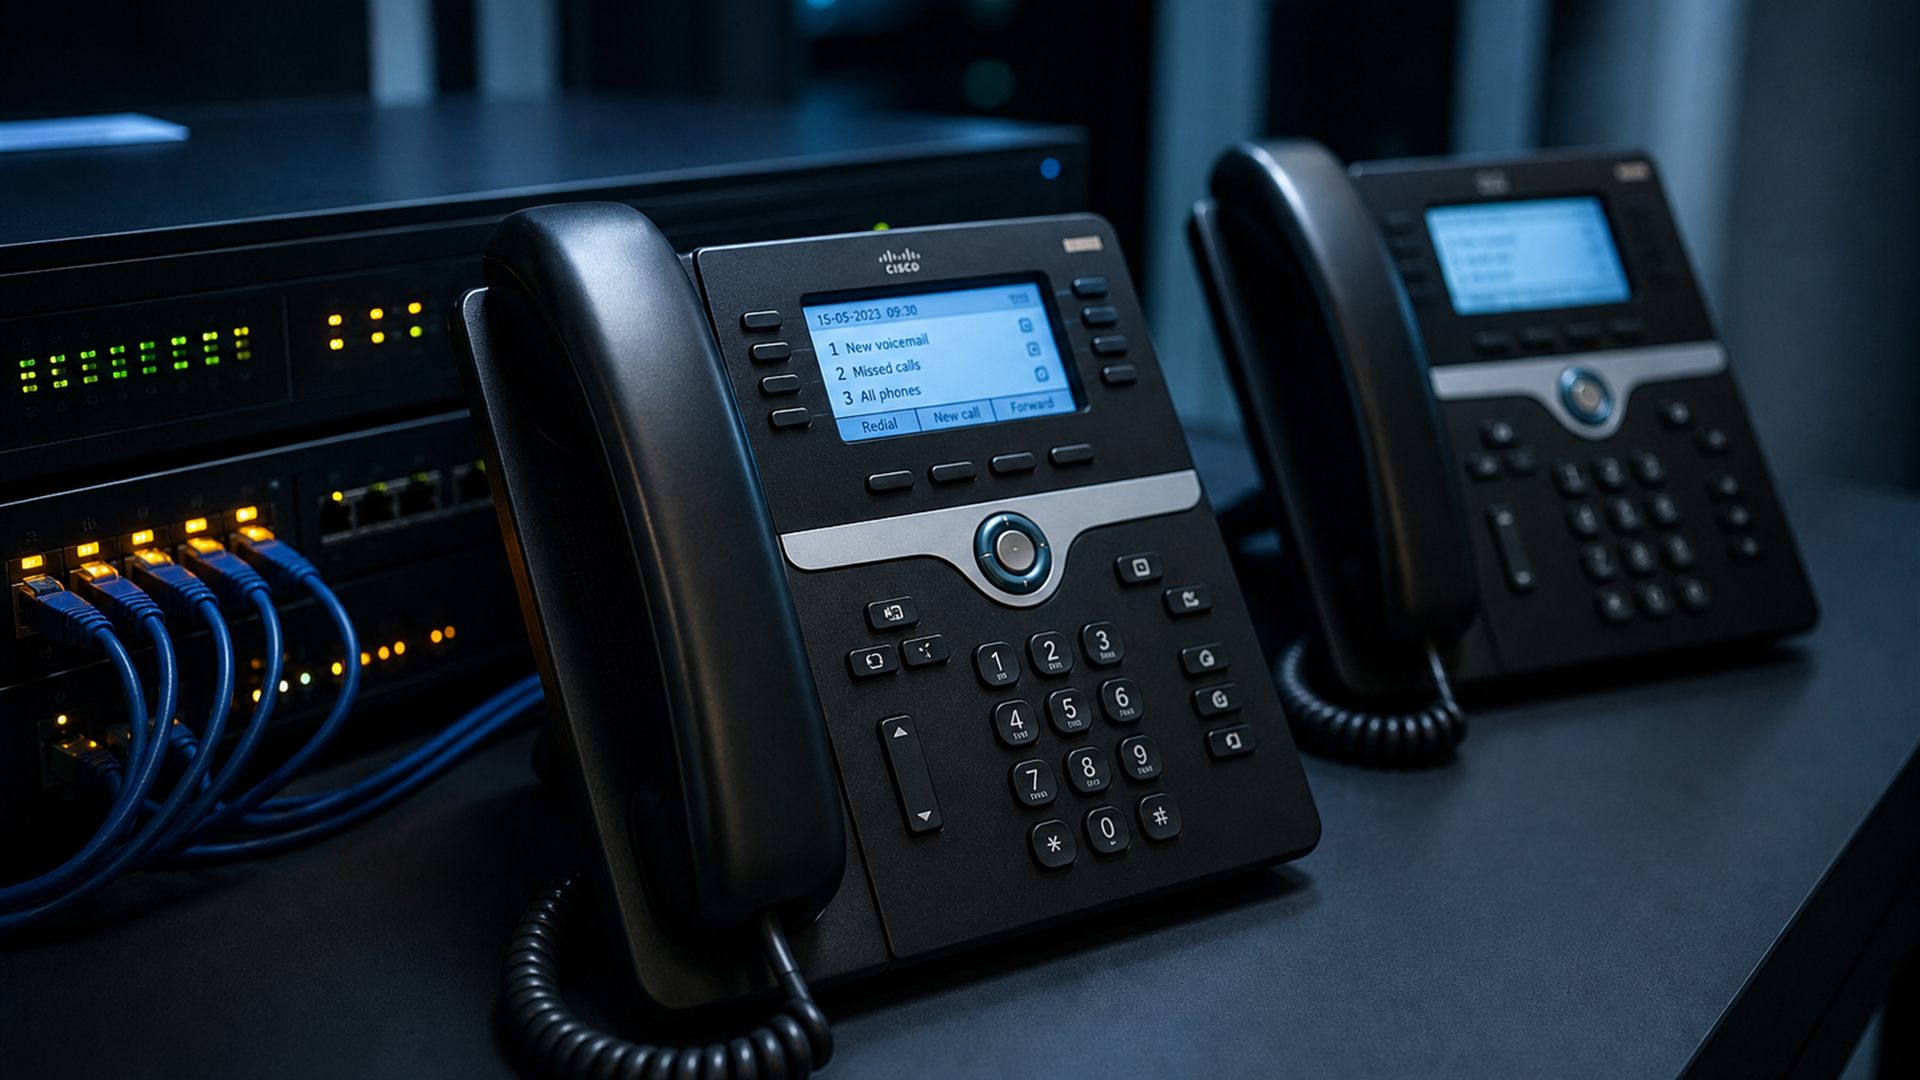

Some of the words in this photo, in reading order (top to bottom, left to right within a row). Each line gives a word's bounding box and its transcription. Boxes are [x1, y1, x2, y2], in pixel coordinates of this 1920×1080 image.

[886, 262, 920, 275] CISCO
[817, 308, 881, 326] 15-05-2023
[887, 304, 917, 318] 09:30
[829, 343, 839, 356] 1
[846, 341, 872, 355] New
[876, 333, 929, 351] voicemail
[836, 367, 847, 381] 2
[853, 363, 893, 379] Missed
[896, 359, 921, 373] calls
[843, 391, 853, 405] 3
[861, 389, 876, 403] All
[880, 384, 921, 403] phones
[1010, 397, 1054, 413] Forward
[862, 417, 898, 433] Redial
[934, 411, 958, 424] New
[961, 407, 981, 420] call
[1043, 640, 1059, 661] 2
[1096, 630, 1110, 651] 3
[991, 651, 1003, 672] 1
[1115, 686, 1129, 707] 6
[1063, 697, 1077, 718] 5
[1010, 709, 1024, 730] 4
[1133, 744, 1147, 765] 9
[1081, 756, 1096, 778] 8
[1026, 769, 1038, 790] 7
[1100, 817, 1115, 839] 0
